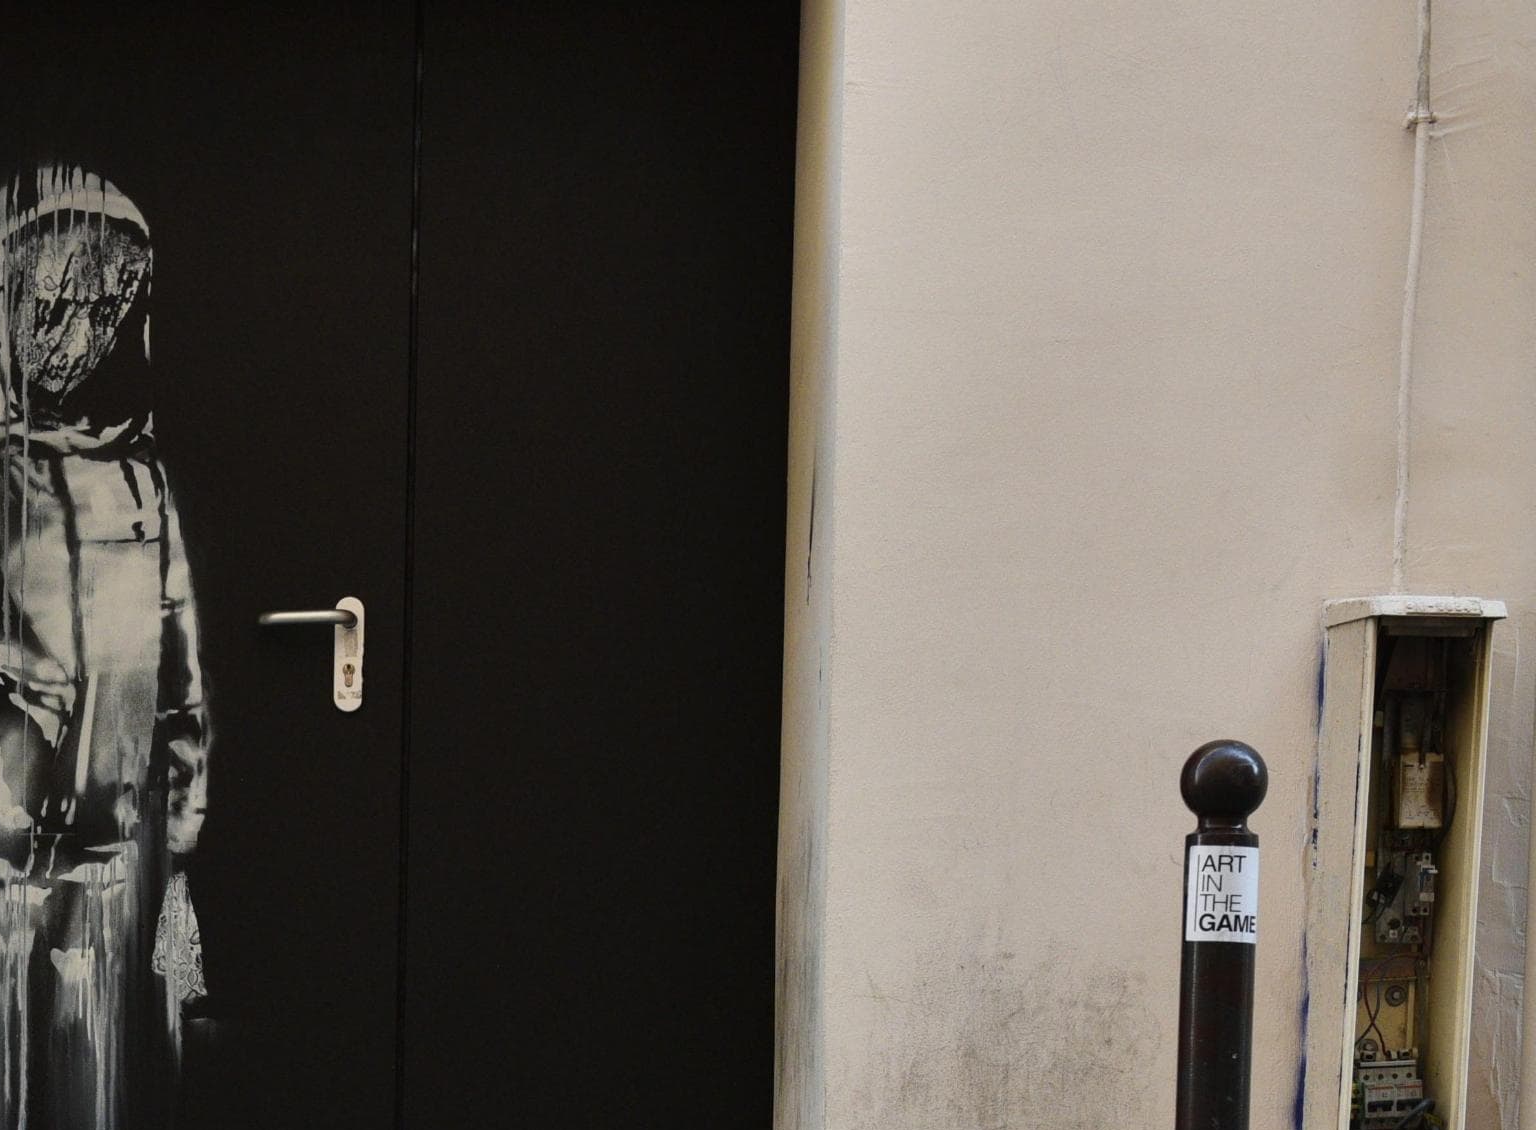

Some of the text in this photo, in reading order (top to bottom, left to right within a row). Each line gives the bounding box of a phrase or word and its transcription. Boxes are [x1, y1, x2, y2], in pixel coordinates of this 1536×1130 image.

[1202, 854, 1247, 873] ART
[1201, 874, 1222, 892] IN
[1200, 893, 1242, 912] THE
[1199, 913, 1256, 933] GAME
